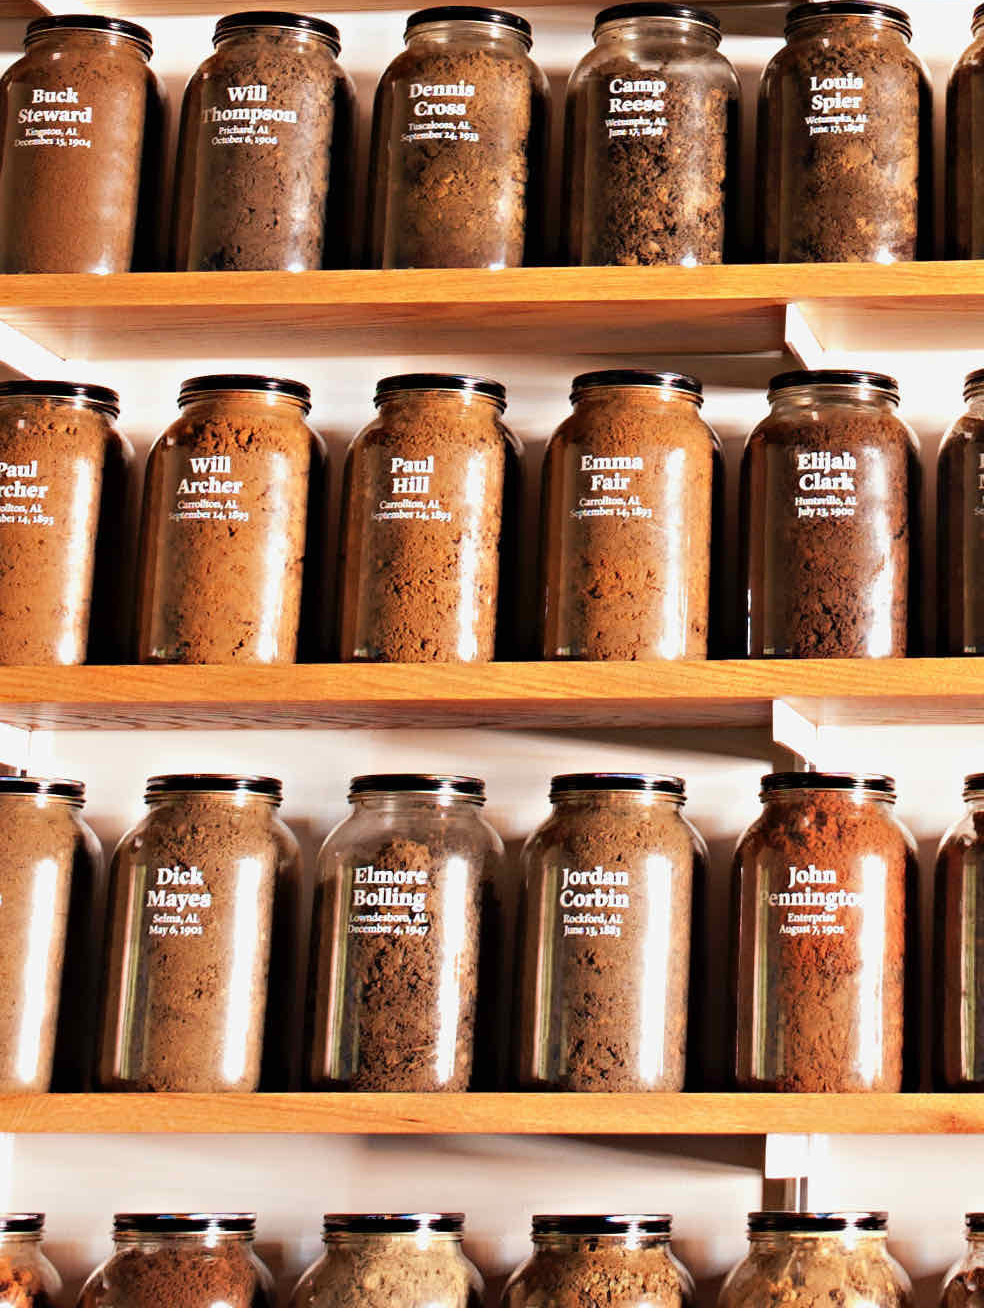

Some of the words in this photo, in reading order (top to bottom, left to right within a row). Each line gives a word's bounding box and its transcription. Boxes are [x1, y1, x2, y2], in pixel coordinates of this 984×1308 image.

[409, 80, 475, 98] Dennis
[609, 78, 667, 97] Camp
[809, 73, 864, 91] Louis
[32, 87, 79, 104] Buck
[226, 85, 268, 102] Will
[414, 101, 466, 116] Cross
[608, 98, 665, 114] Reese
[811, 93, 863, 113] Spier
[18, 107, 93, 124] Steward
[203, 107, 297, 124] Thompson
[15, 136, 55, 148] December
[69, 138, 92, 148] 1904
[190, 455, 231, 473] Will
[390, 455, 434, 474] Paul
[581, 455, 644, 470] Emma
[797, 452, 857, 474] Elijah
[177, 476, 244, 495] Archer
[391, 475, 429, 494] Hill
[590, 472, 631, 491] Fair
[799, 472, 856, 491] Clark
[798, 506, 815, 518] July
[156, 866, 204, 885] Dick
[354, 866, 428, 885] Elmore
[561, 866, 628, 889] Jordan
[788, 865, 837, 888] John
[146, 889, 212, 912] Mayes
[353, 887, 427, 911] Bolling
[560, 888, 630, 908] Corbin
[153, 913, 183, 925] Selma,
[185, 913, 200, 924] AL
[563, 913, 606, 925] Rockford,
[608, 913, 624, 924] AL
[787, 913, 836, 925] Enterprise
[149, 925, 169, 937] May
[179, 924, 203, 935] 1901
[348, 924, 391, 934] December
[405, 924, 428, 935] 1947
[779, 925, 811, 936] August
[822, 925, 844, 935] 1901
